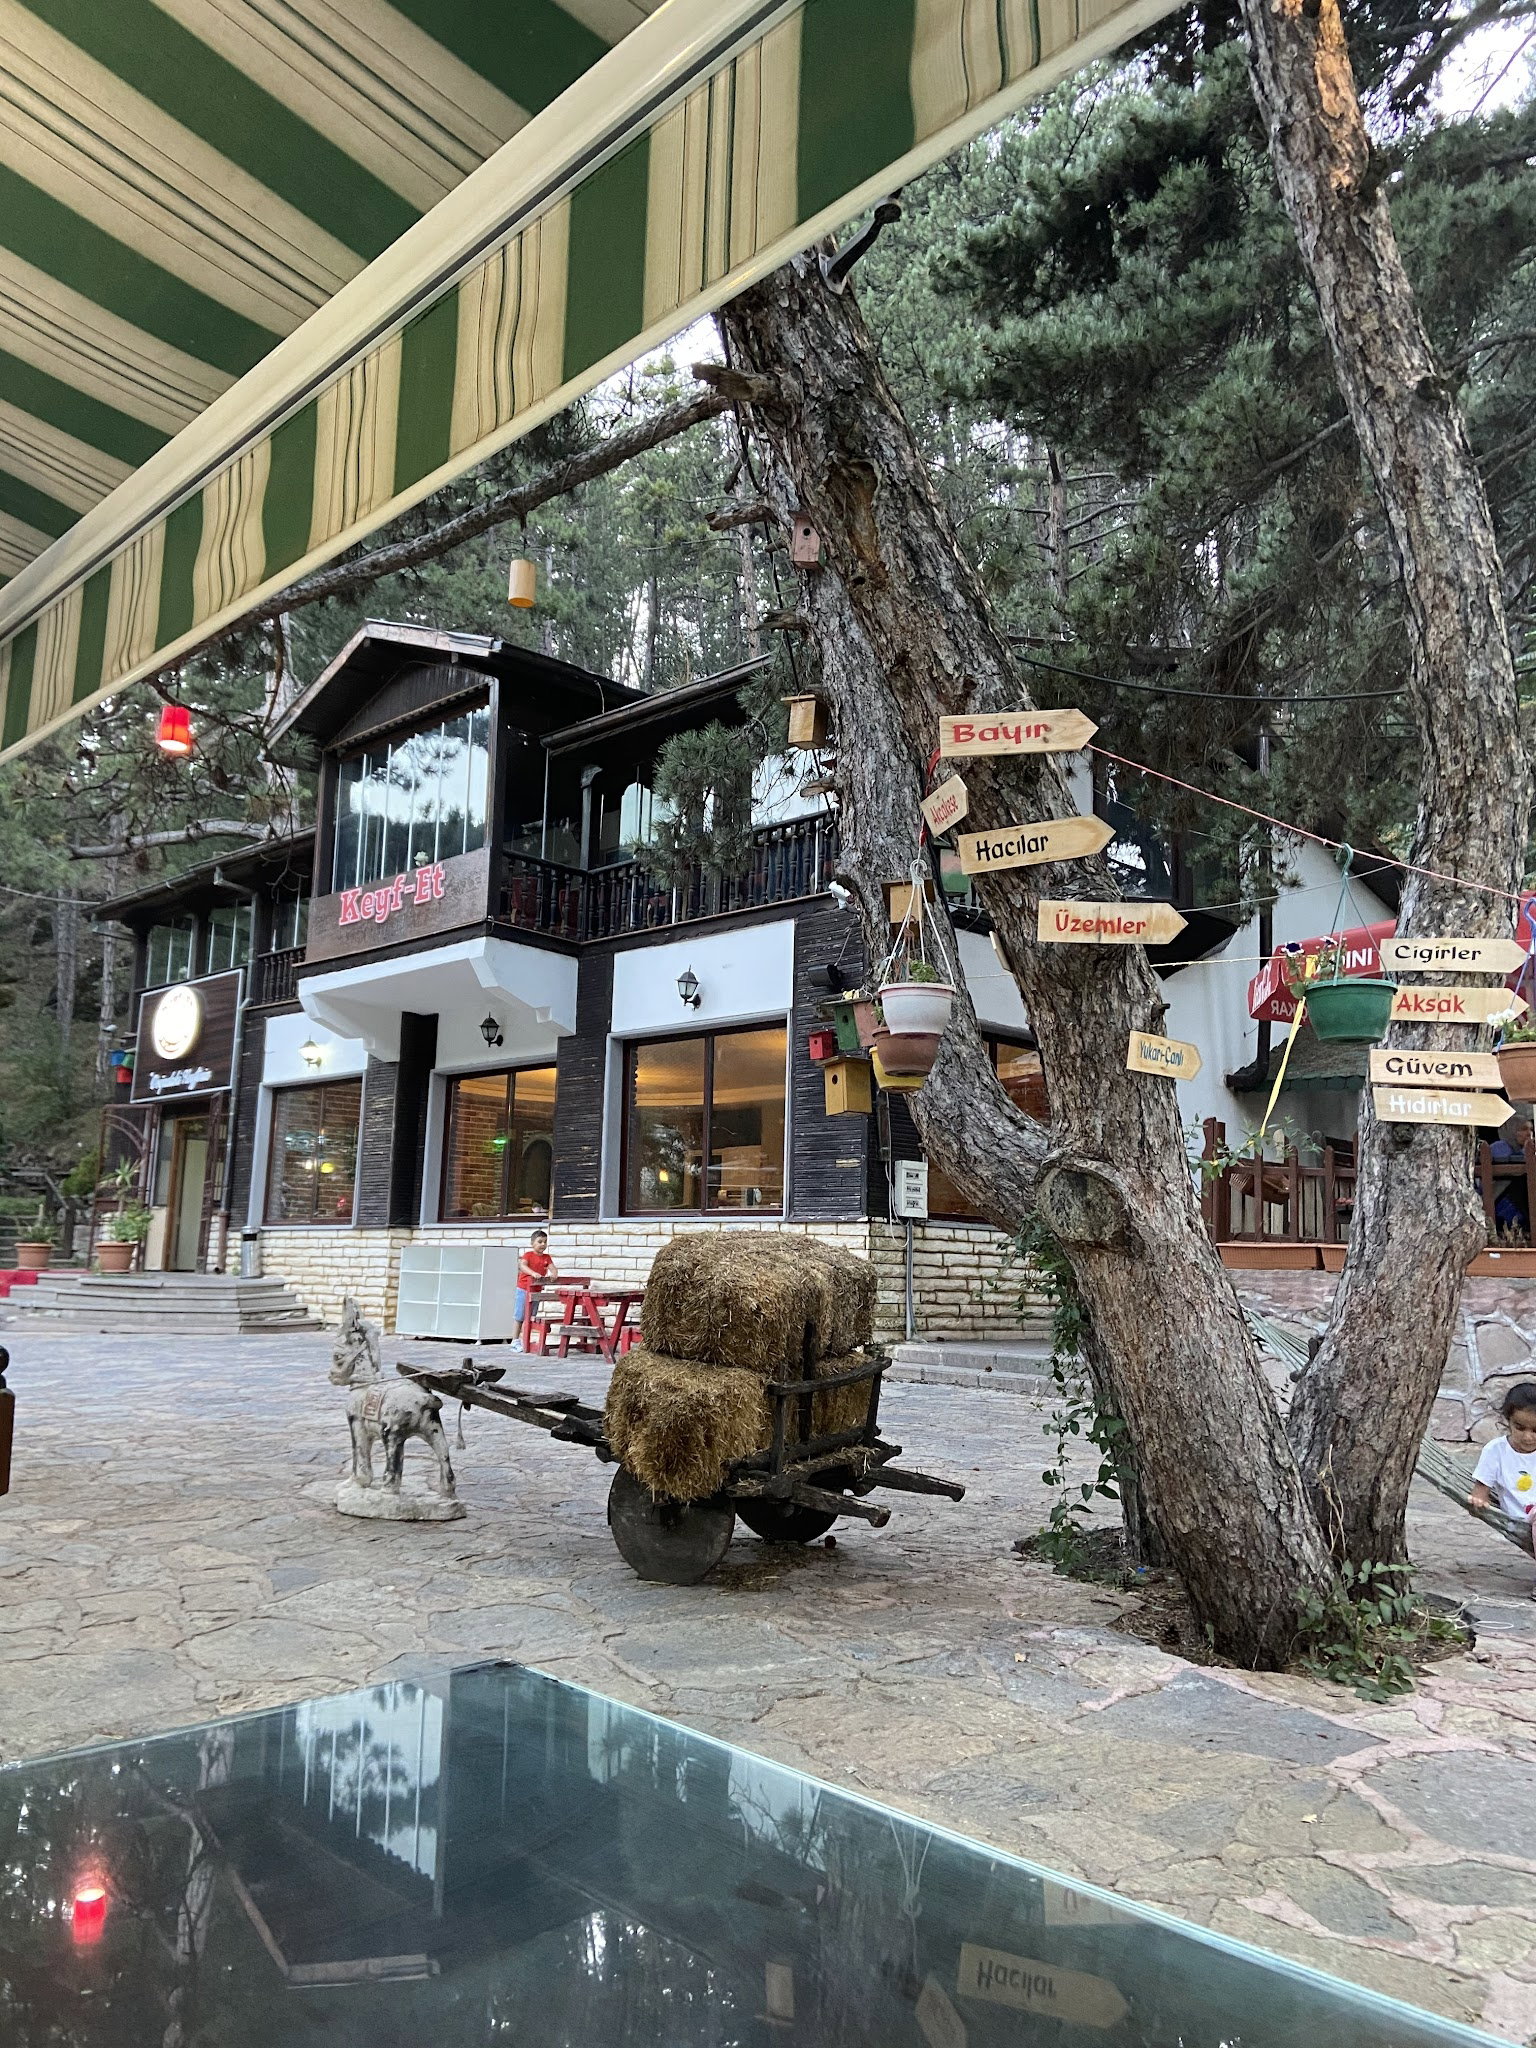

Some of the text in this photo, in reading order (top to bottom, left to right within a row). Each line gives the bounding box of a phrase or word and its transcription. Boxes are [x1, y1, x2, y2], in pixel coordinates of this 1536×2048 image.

[953, 722, 1051, 744] Bayır
[976, 833, 1049, 862] Hacılar
[339, 862, 446, 925] Keyf-Et
[1055, 909, 1147, 935] Üzemler
[1396, 993, 1465, 1014] Aksak
[1385, 1057, 1473, 1077] Güvem
